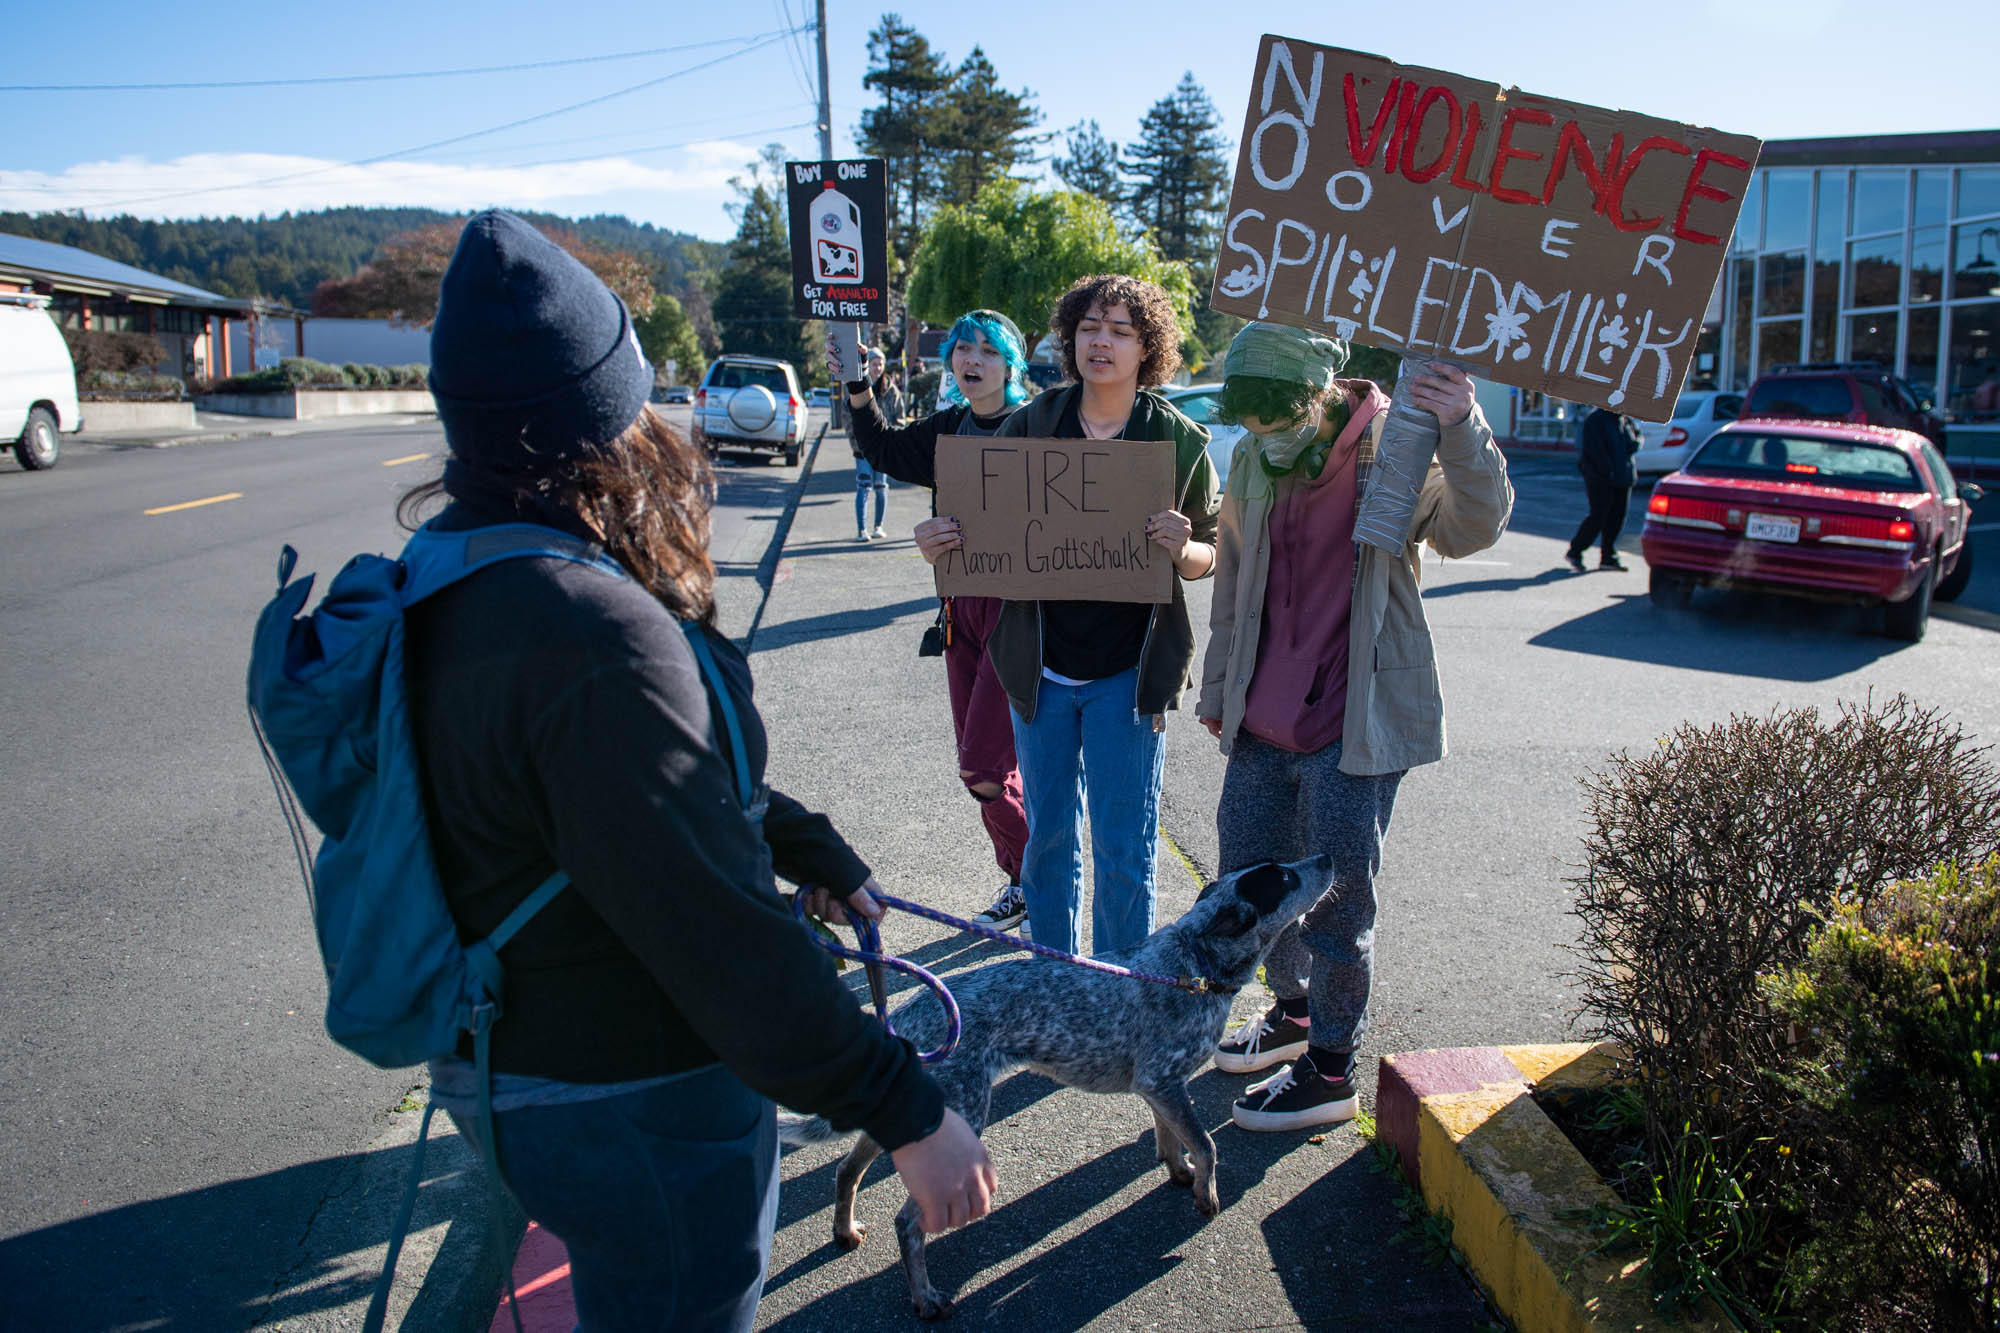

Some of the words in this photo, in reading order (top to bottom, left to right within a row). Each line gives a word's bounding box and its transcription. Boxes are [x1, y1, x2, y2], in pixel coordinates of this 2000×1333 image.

[1248, 40, 1324, 191] NO
[794, 164, 822, 184] BUY
[837, 162, 867, 180] ONE
[1342, 71, 1751, 245] VIOLENCE
[812, 299, 836, 318] FOR
[839, 301, 869, 317] FREE
[826, 285, 878, 300] ASSAULTED
[981, 448, 1110, 514] FIRE
[1025, 519, 1150, 573] Gottschalk!
